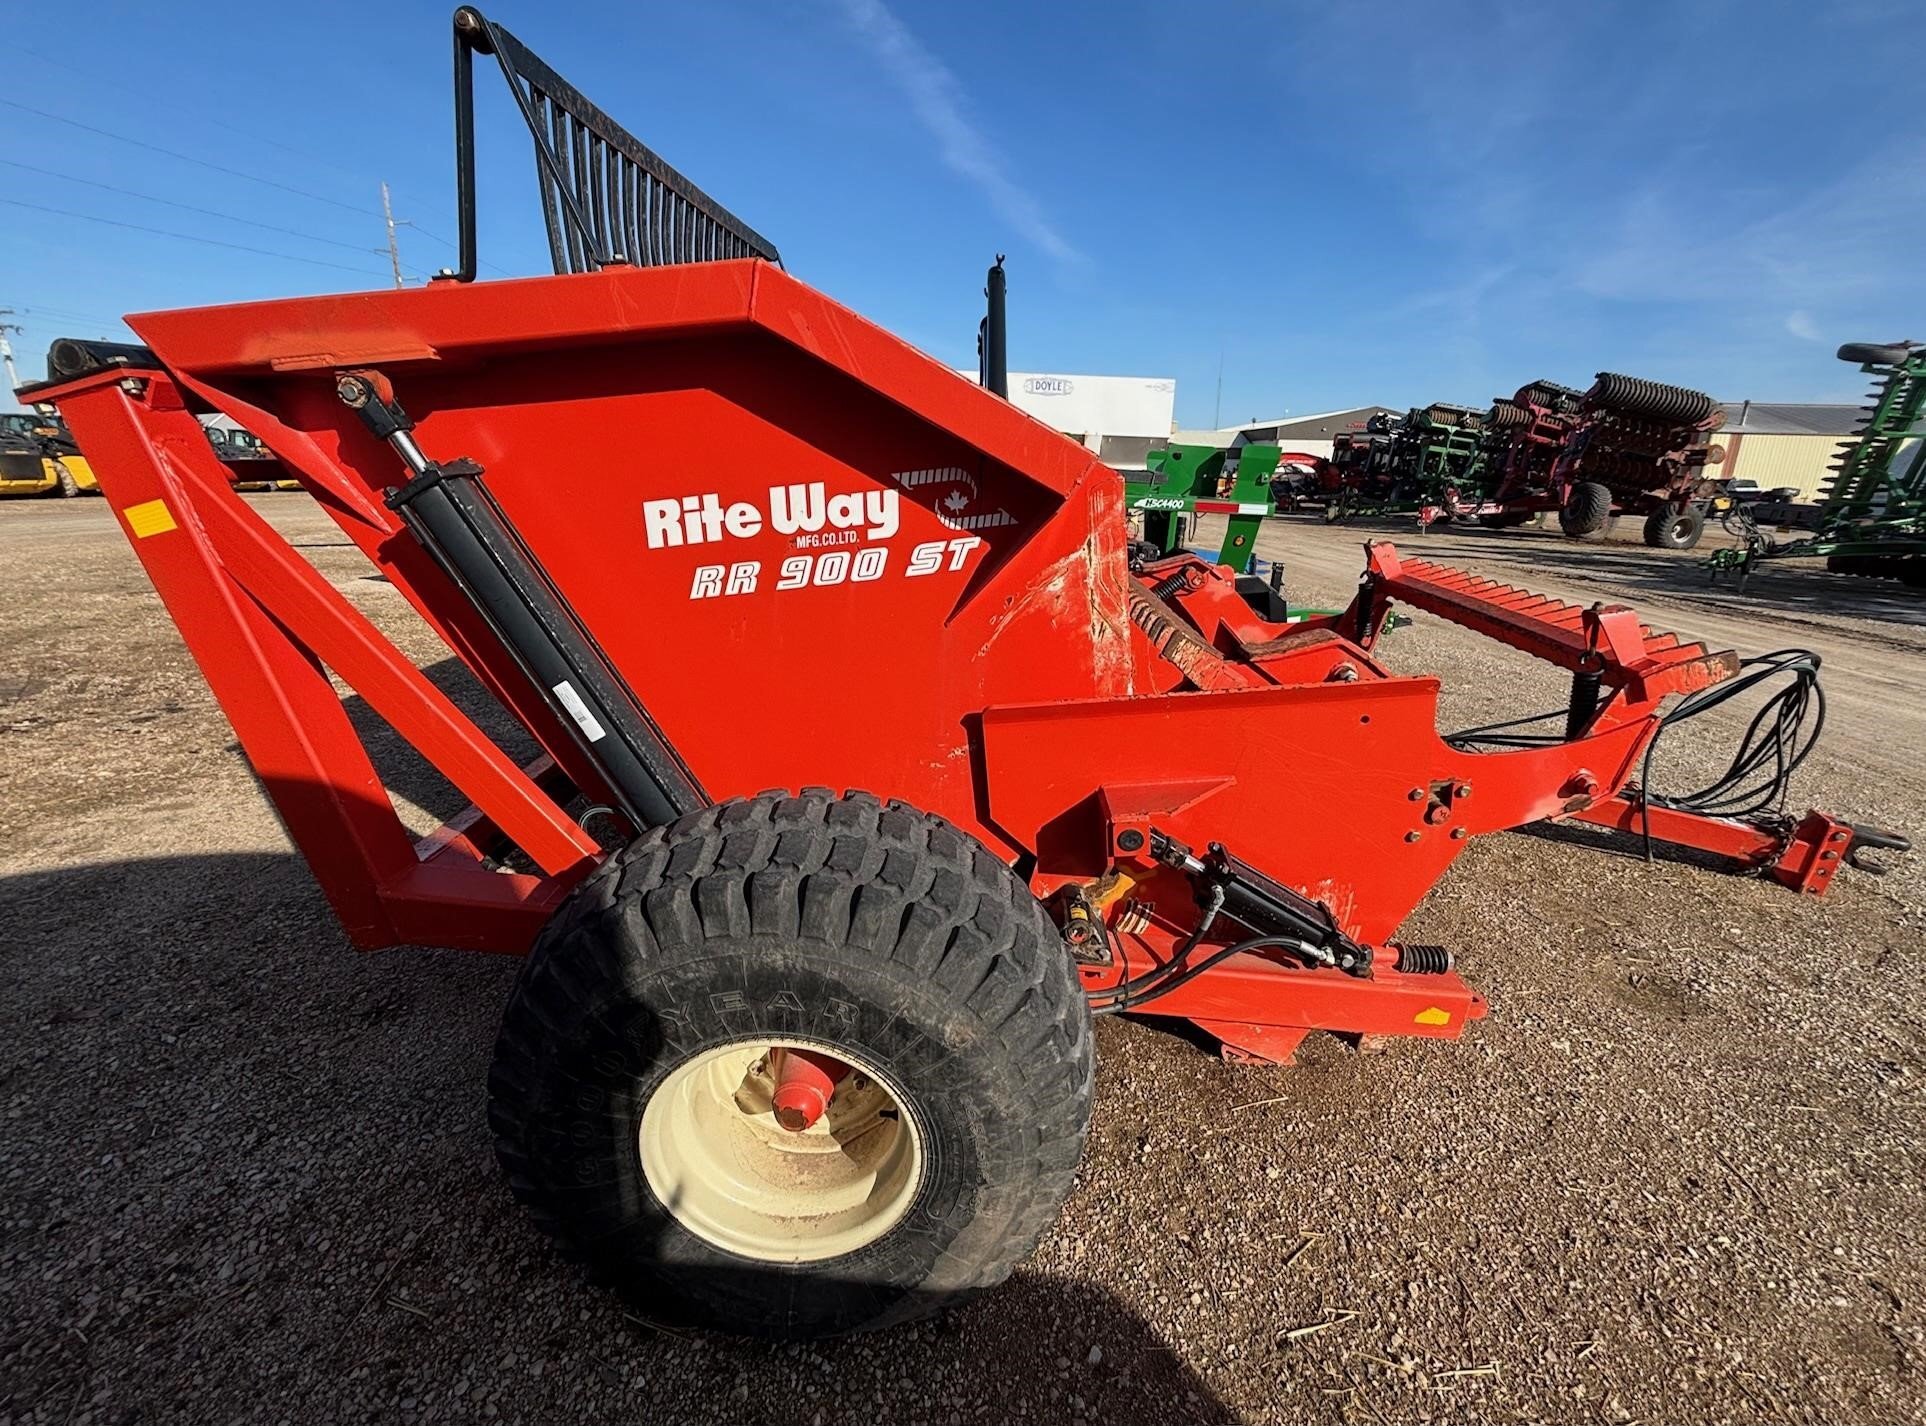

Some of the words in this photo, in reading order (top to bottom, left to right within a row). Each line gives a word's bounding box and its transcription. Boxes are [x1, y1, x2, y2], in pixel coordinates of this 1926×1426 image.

[1035, 380, 1061, 391] DOYLE
[643, 493, 762, 549] Rite
[770, 482, 899, 540] Way
[690, 562, 761, 599] RR
[775, 547, 889, 591] 900
[905, 537, 982, 577] ST
